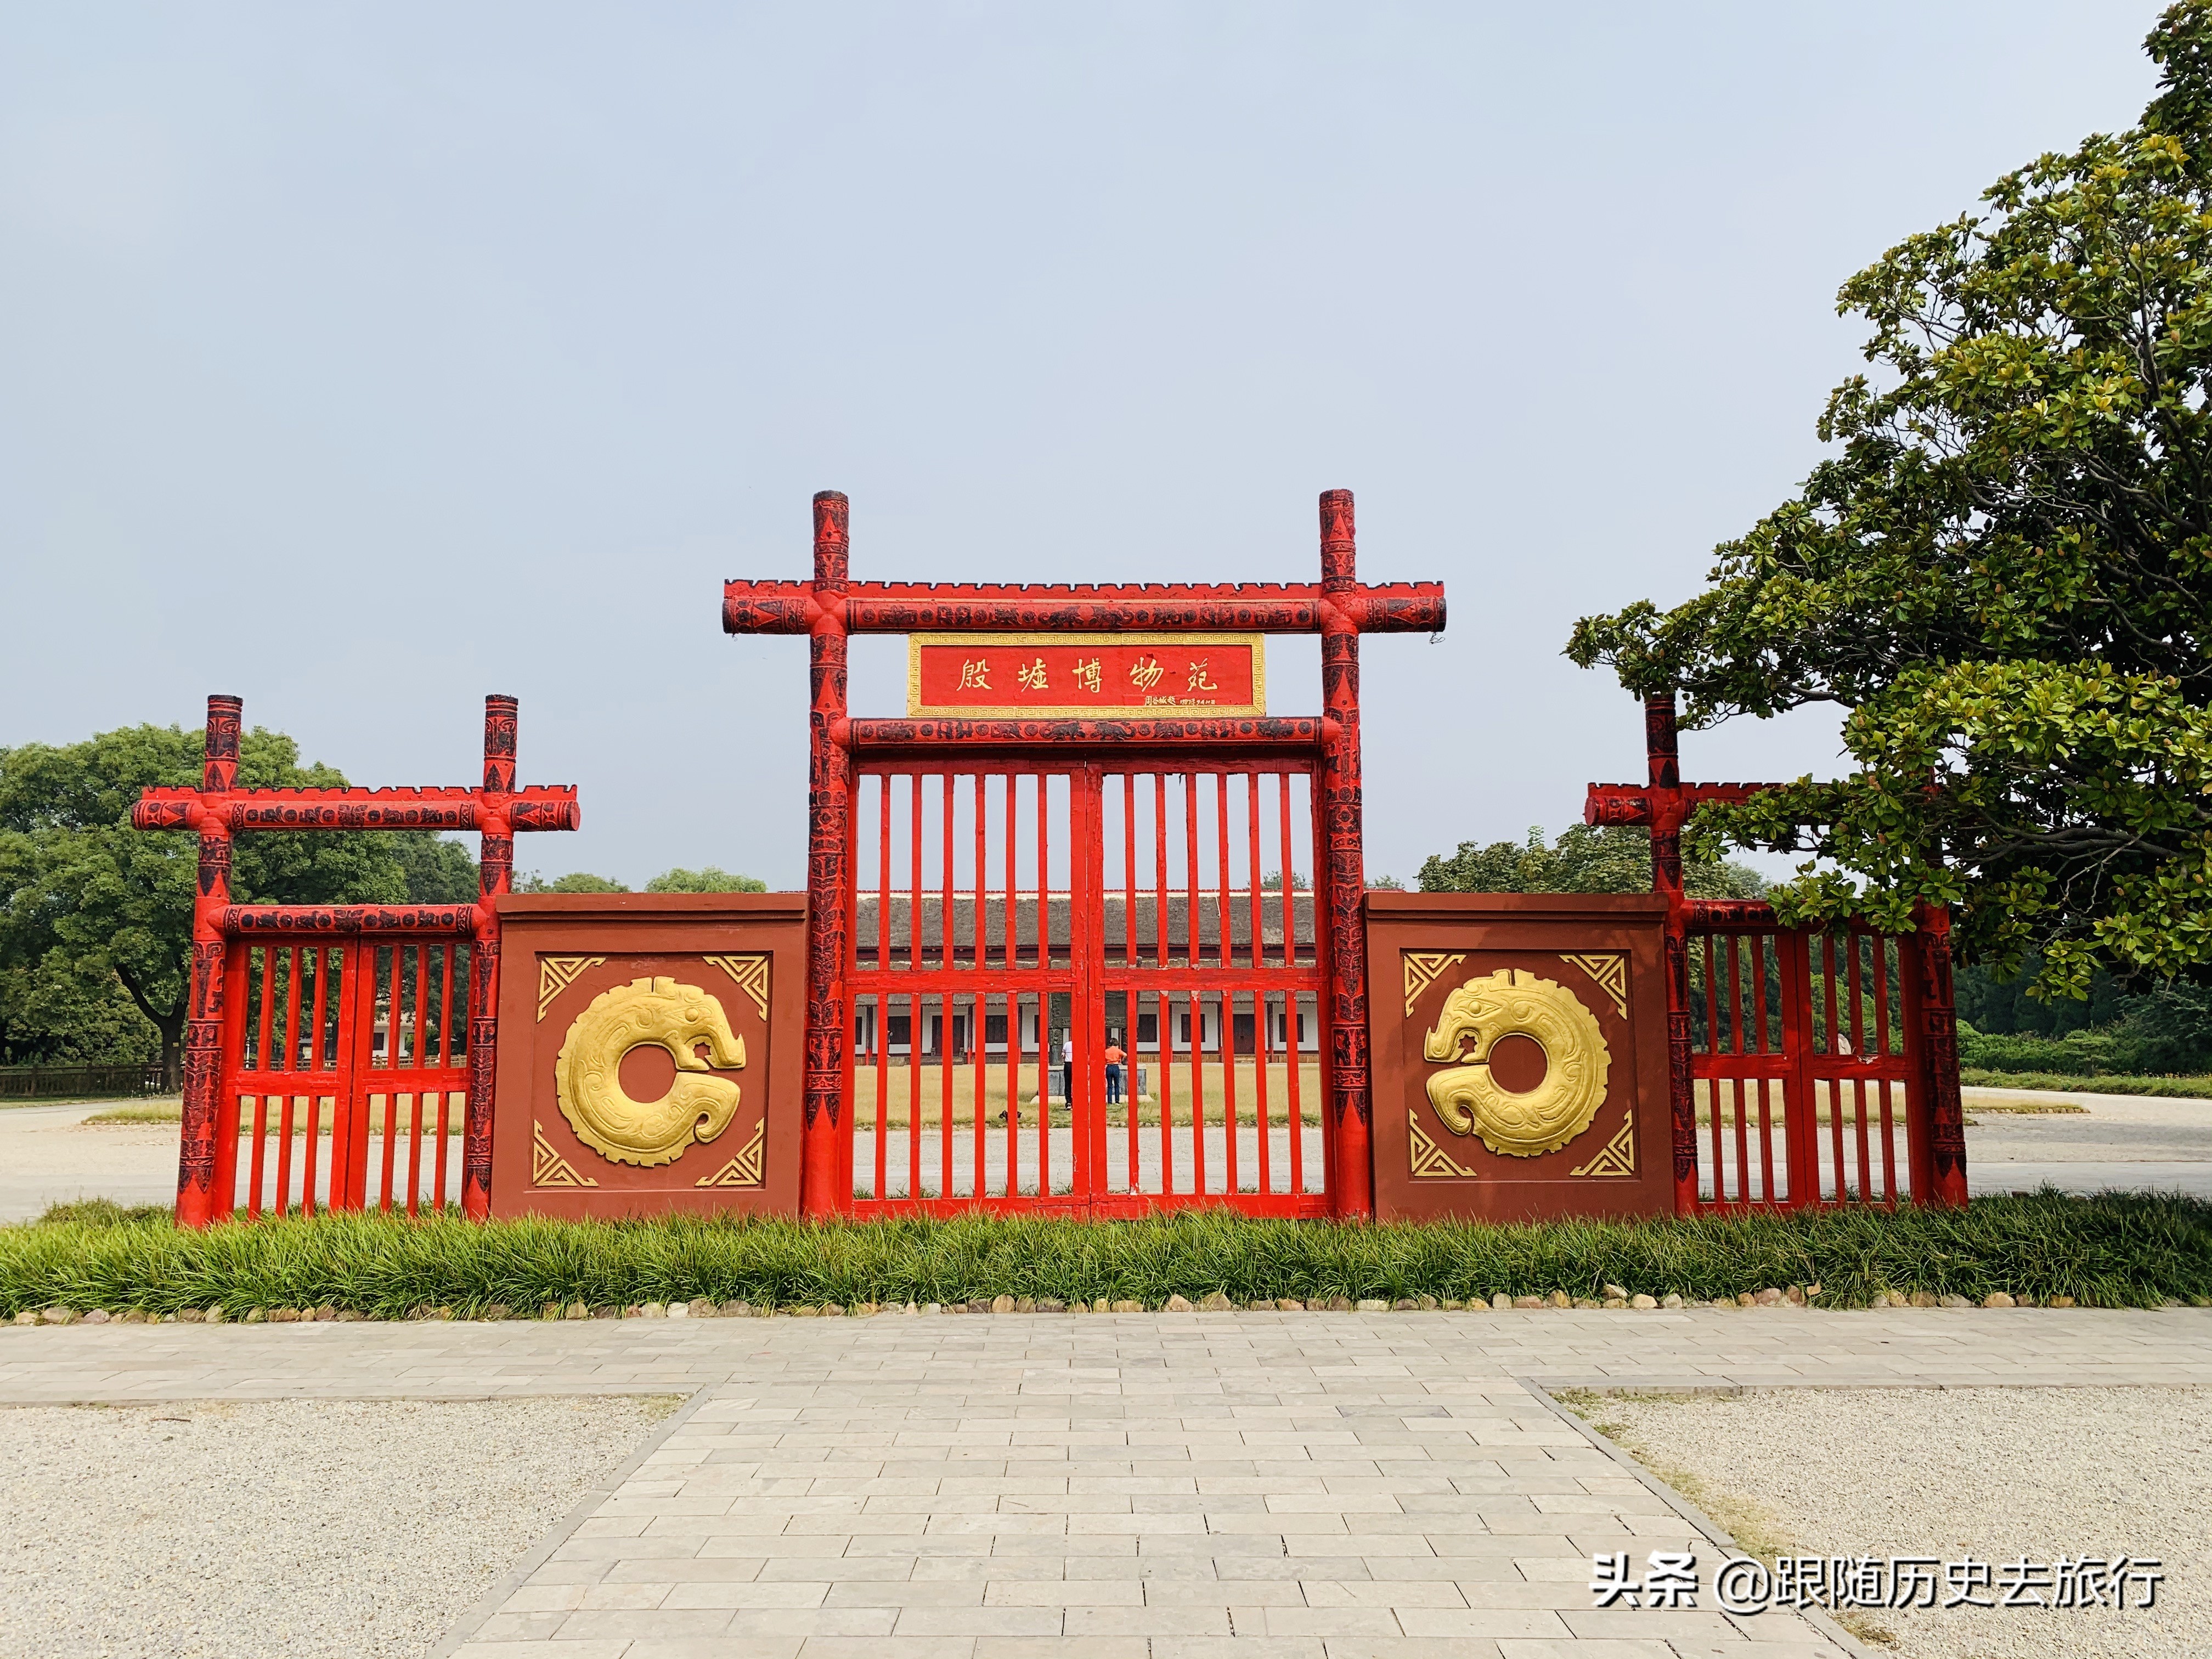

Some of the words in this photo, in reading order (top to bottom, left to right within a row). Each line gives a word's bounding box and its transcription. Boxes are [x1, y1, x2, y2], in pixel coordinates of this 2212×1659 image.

[956, 657, 1217, 692] 殷墟博物苑
